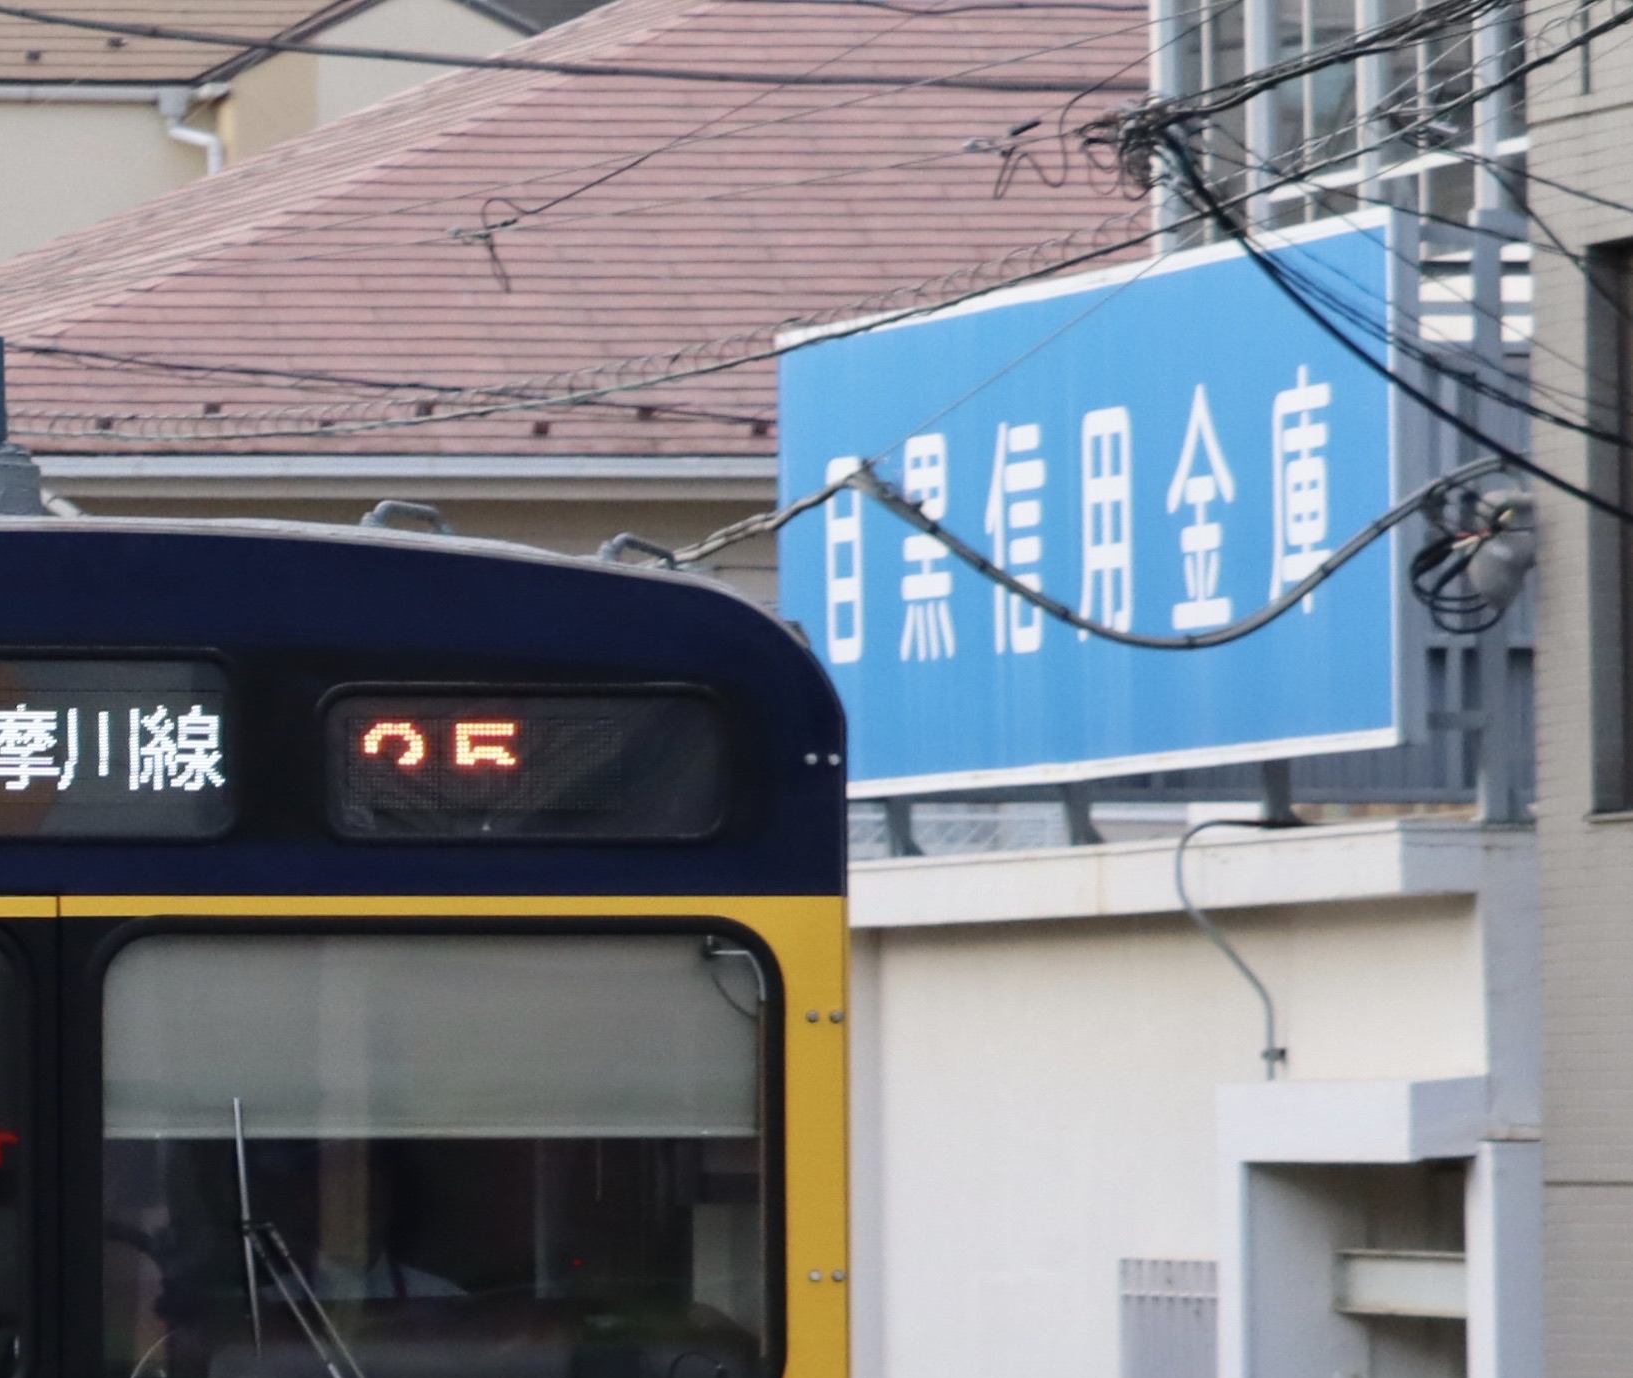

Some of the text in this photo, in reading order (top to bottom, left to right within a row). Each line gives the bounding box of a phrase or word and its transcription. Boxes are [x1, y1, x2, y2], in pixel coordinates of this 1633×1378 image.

[826, 364, 1333, 665] 目黒信用金庫
